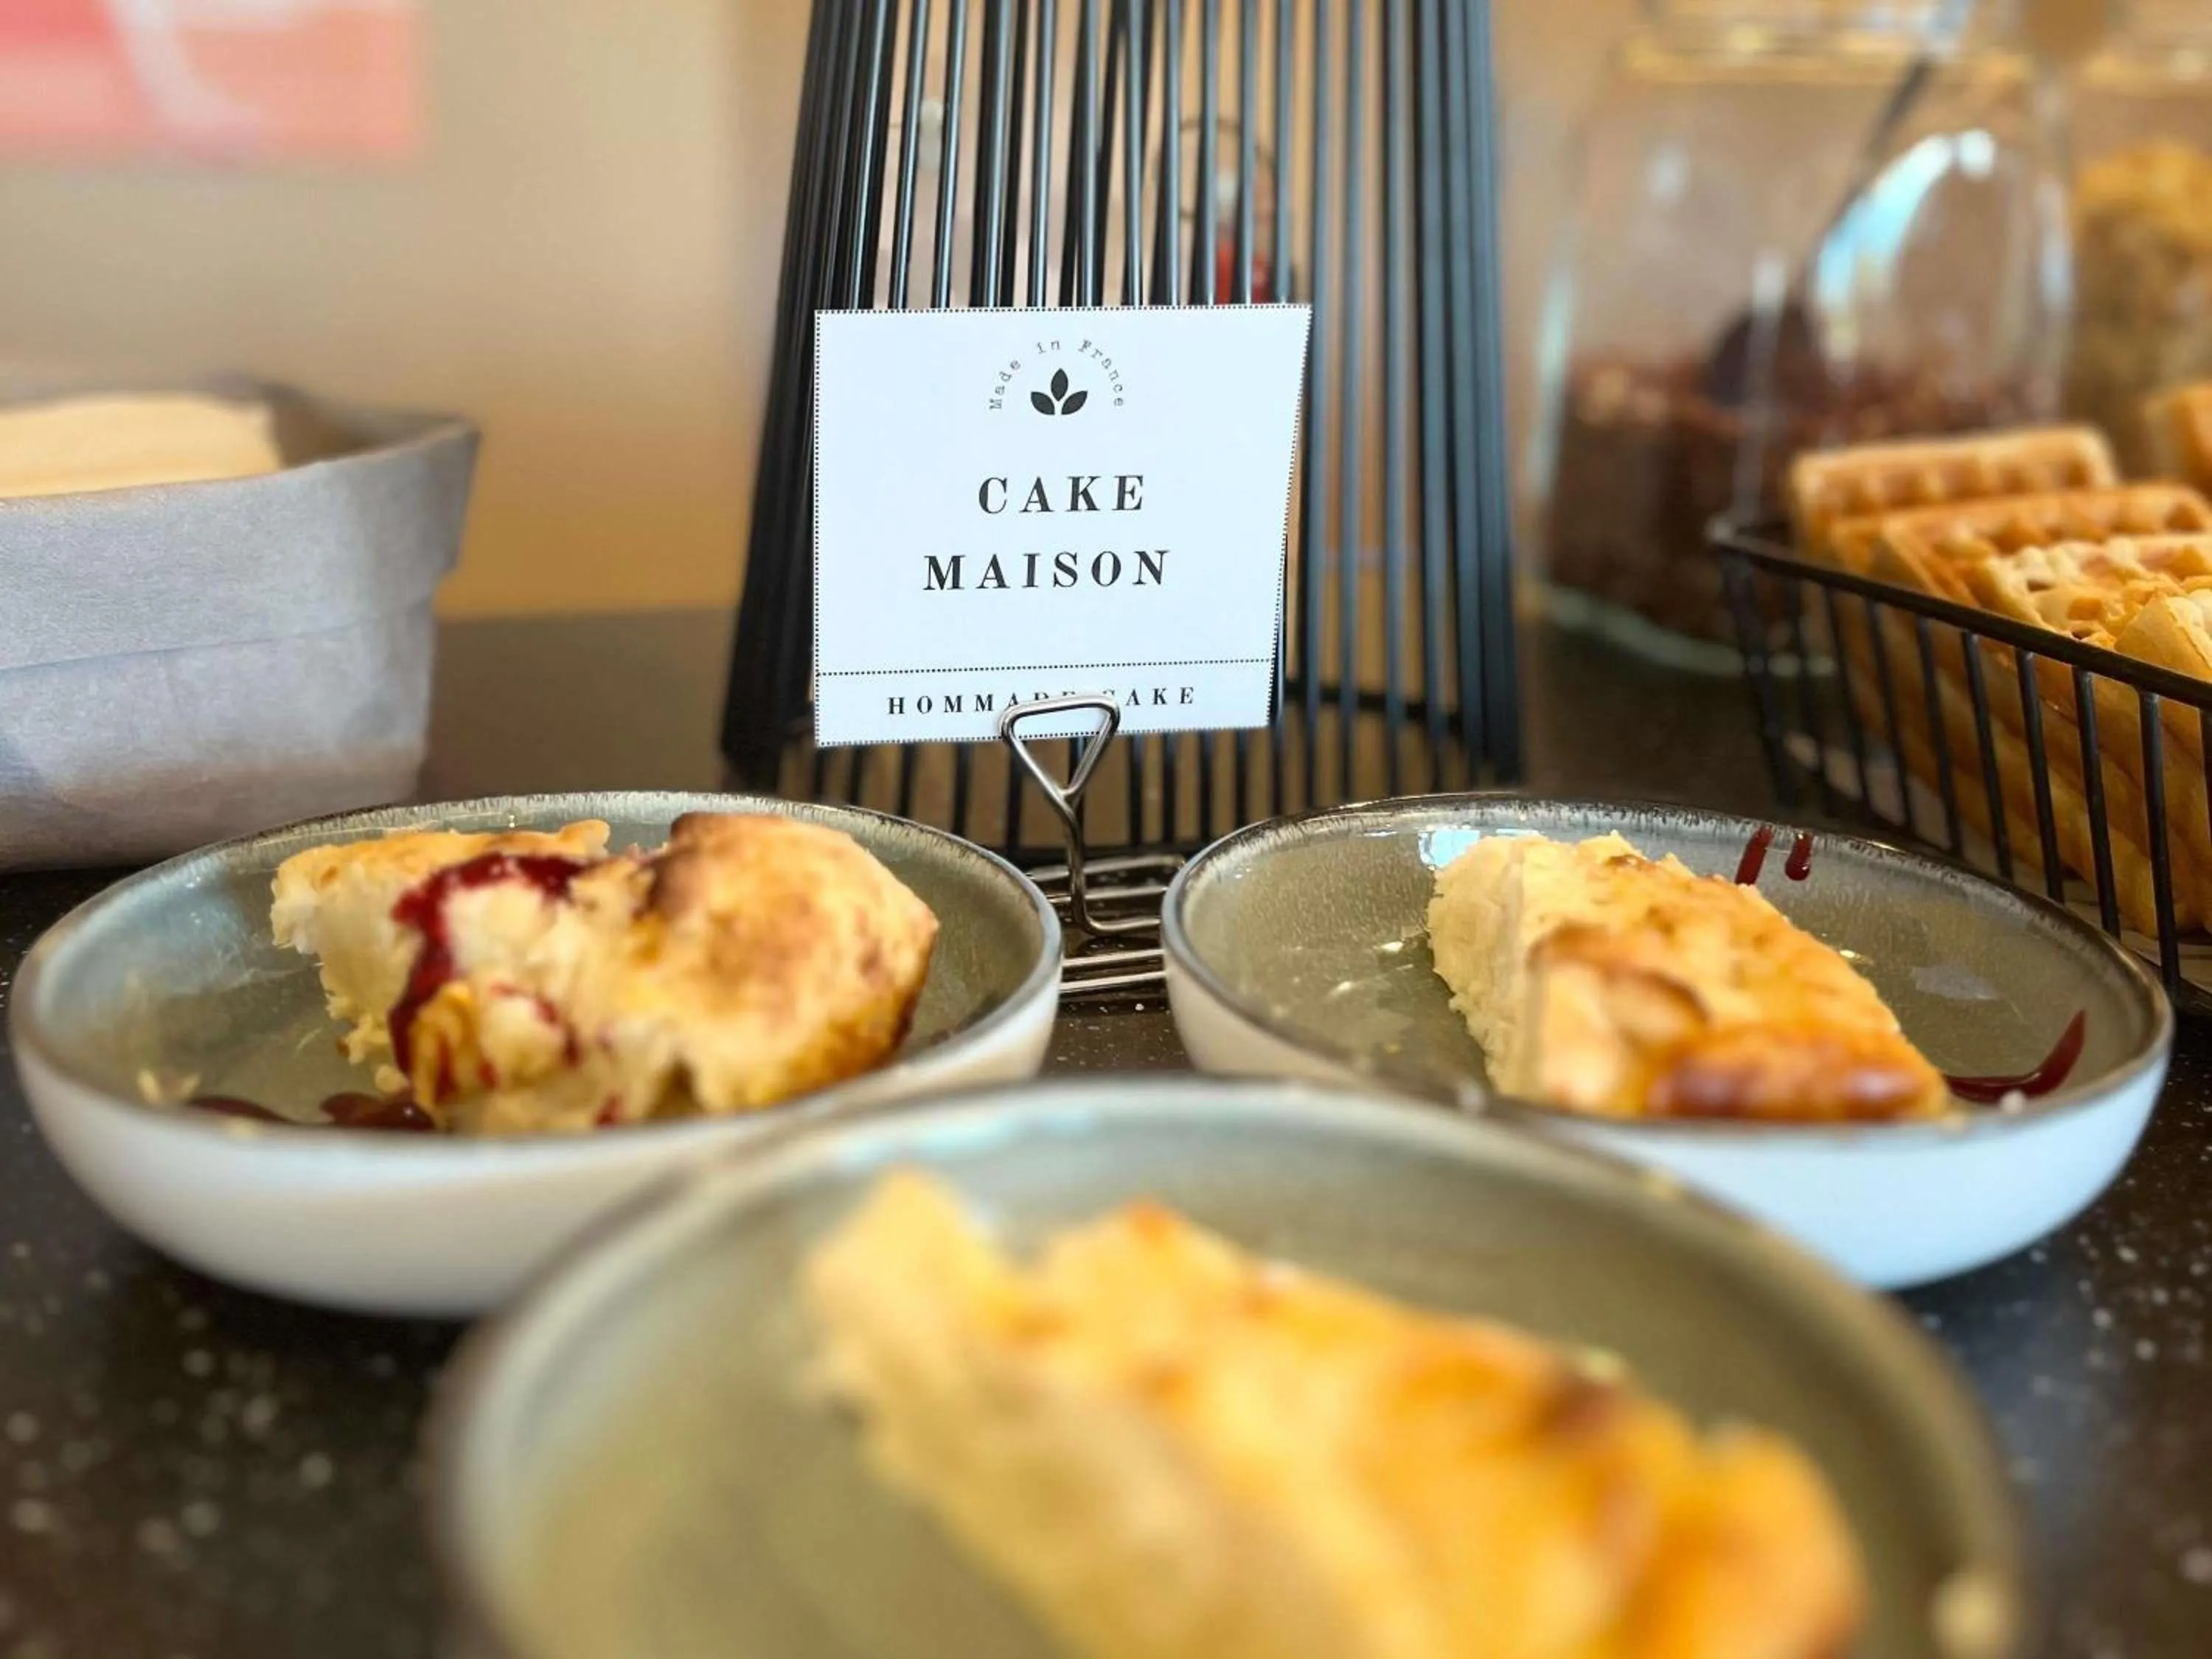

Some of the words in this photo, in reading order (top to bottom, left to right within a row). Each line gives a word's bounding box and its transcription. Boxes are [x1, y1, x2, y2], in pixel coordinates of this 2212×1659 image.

[989, 359, 1022, 410] Made
[1037, 340, 1061, 355] in
[1077, 339, 1124, 407] France
[978, 474, 1144, 515] CAKE
[922, 549, 1169, 591] MAISON
[887, 691, 1077, 715] HOMMA
[1102, 686, 1194, 708] AKE
